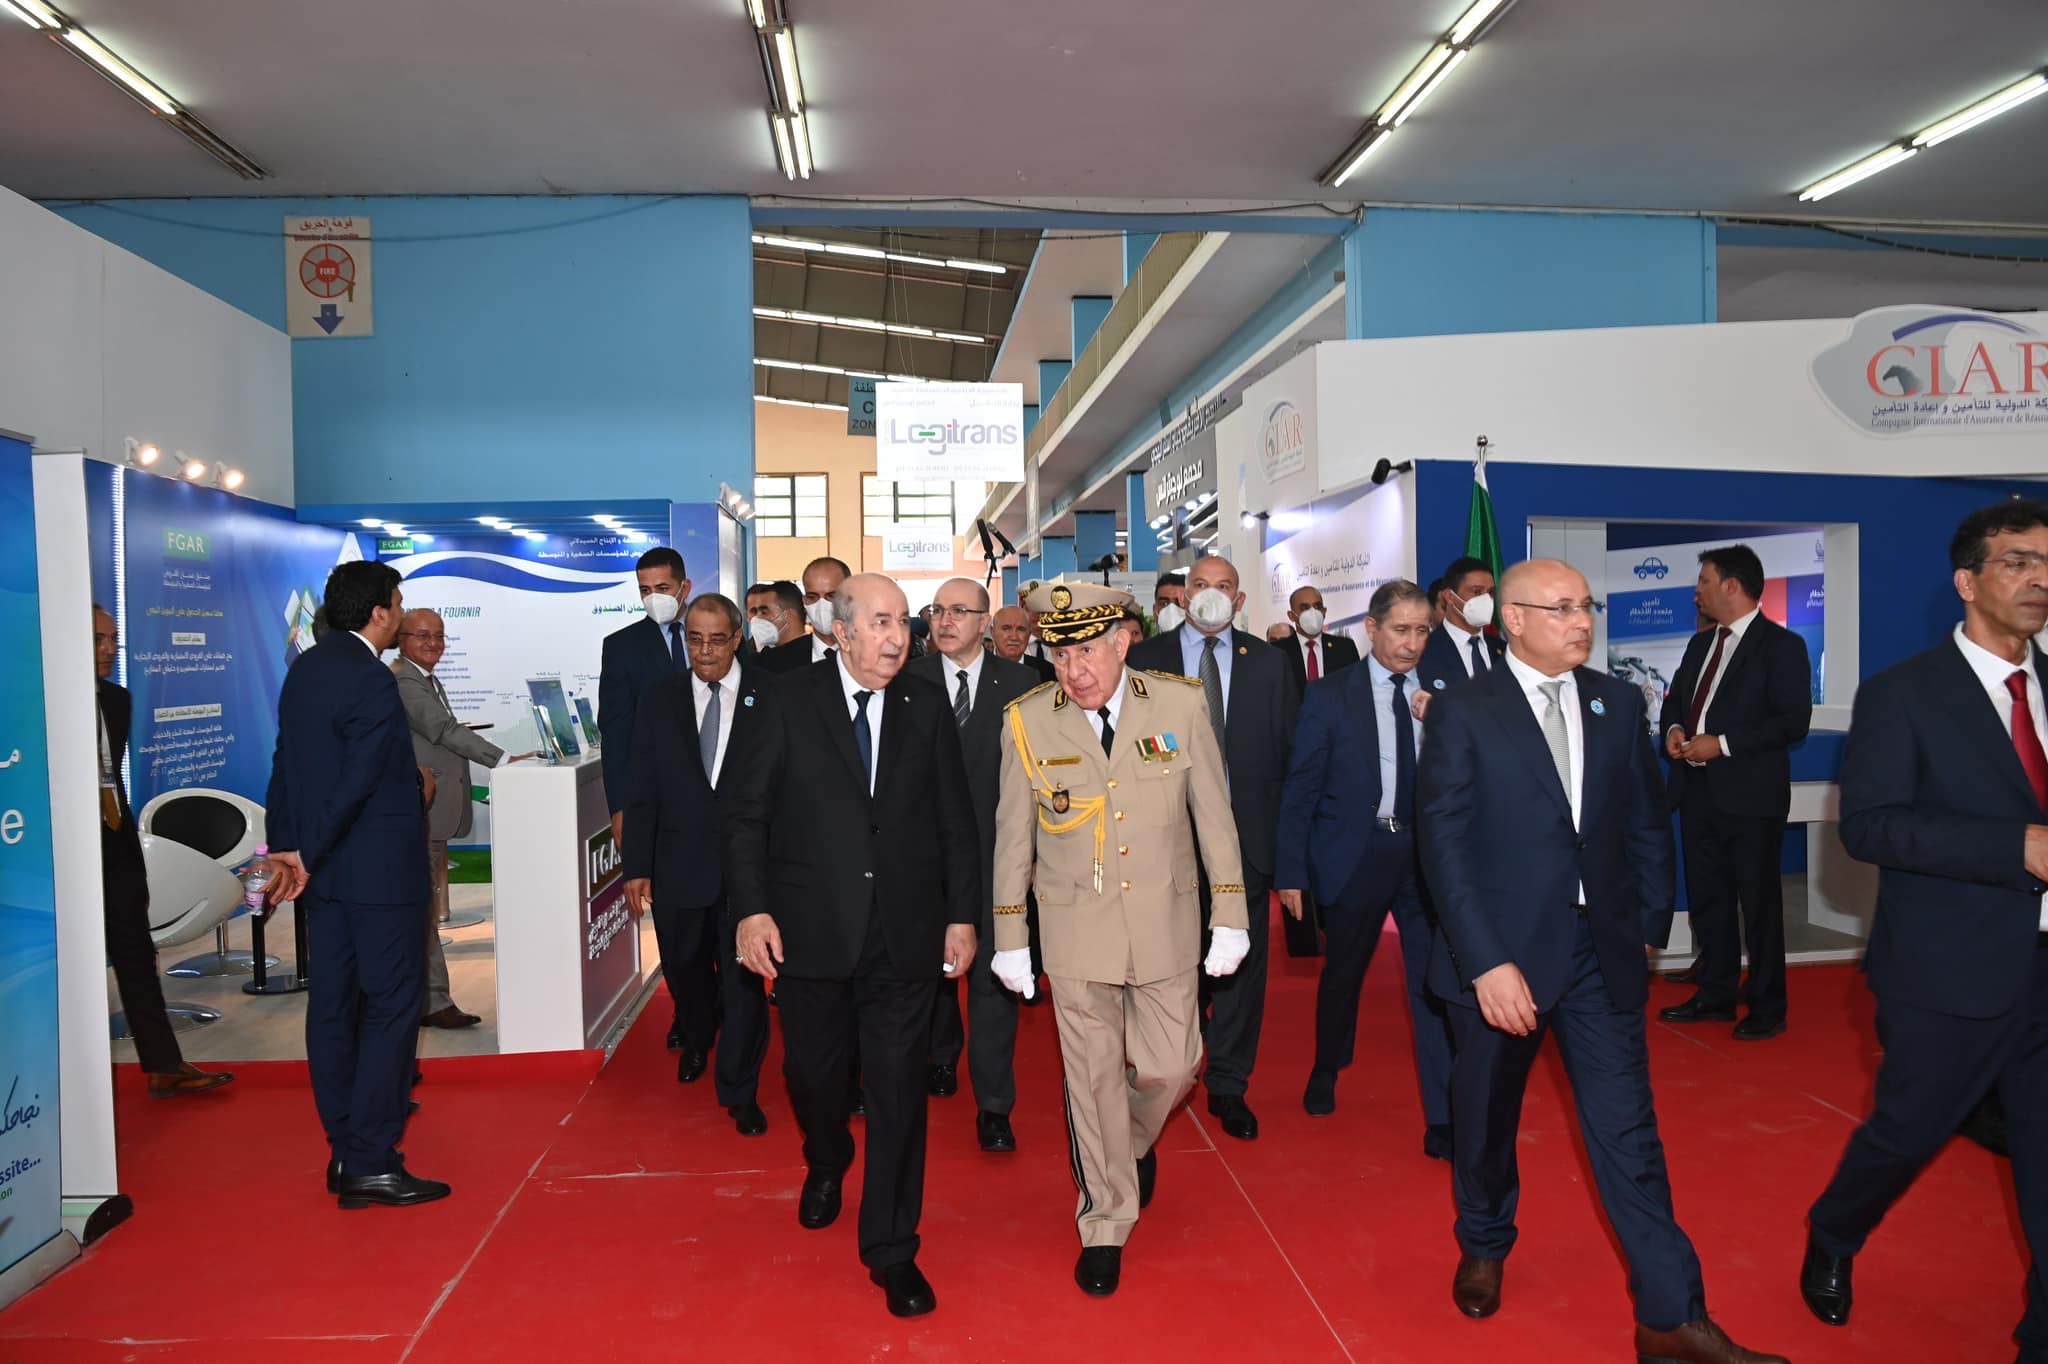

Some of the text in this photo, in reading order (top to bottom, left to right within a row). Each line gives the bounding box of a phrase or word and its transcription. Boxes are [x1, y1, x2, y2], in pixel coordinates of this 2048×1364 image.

[320, 267, 336, 275] FIRE
[852, 419, 876, 429] ZON
[1872, 416, 1910, 428] Compagnie
[1912, 414, 1961, 426] Internationale
[890, 418, 1017, 456] Logitrans
[167, 531, 204, 553] FGAR
[382, 539, 409, 549] FGAR
[889, 540, 950, 558] Logitrans
[443, 606, 481, 618] FOURNIR
